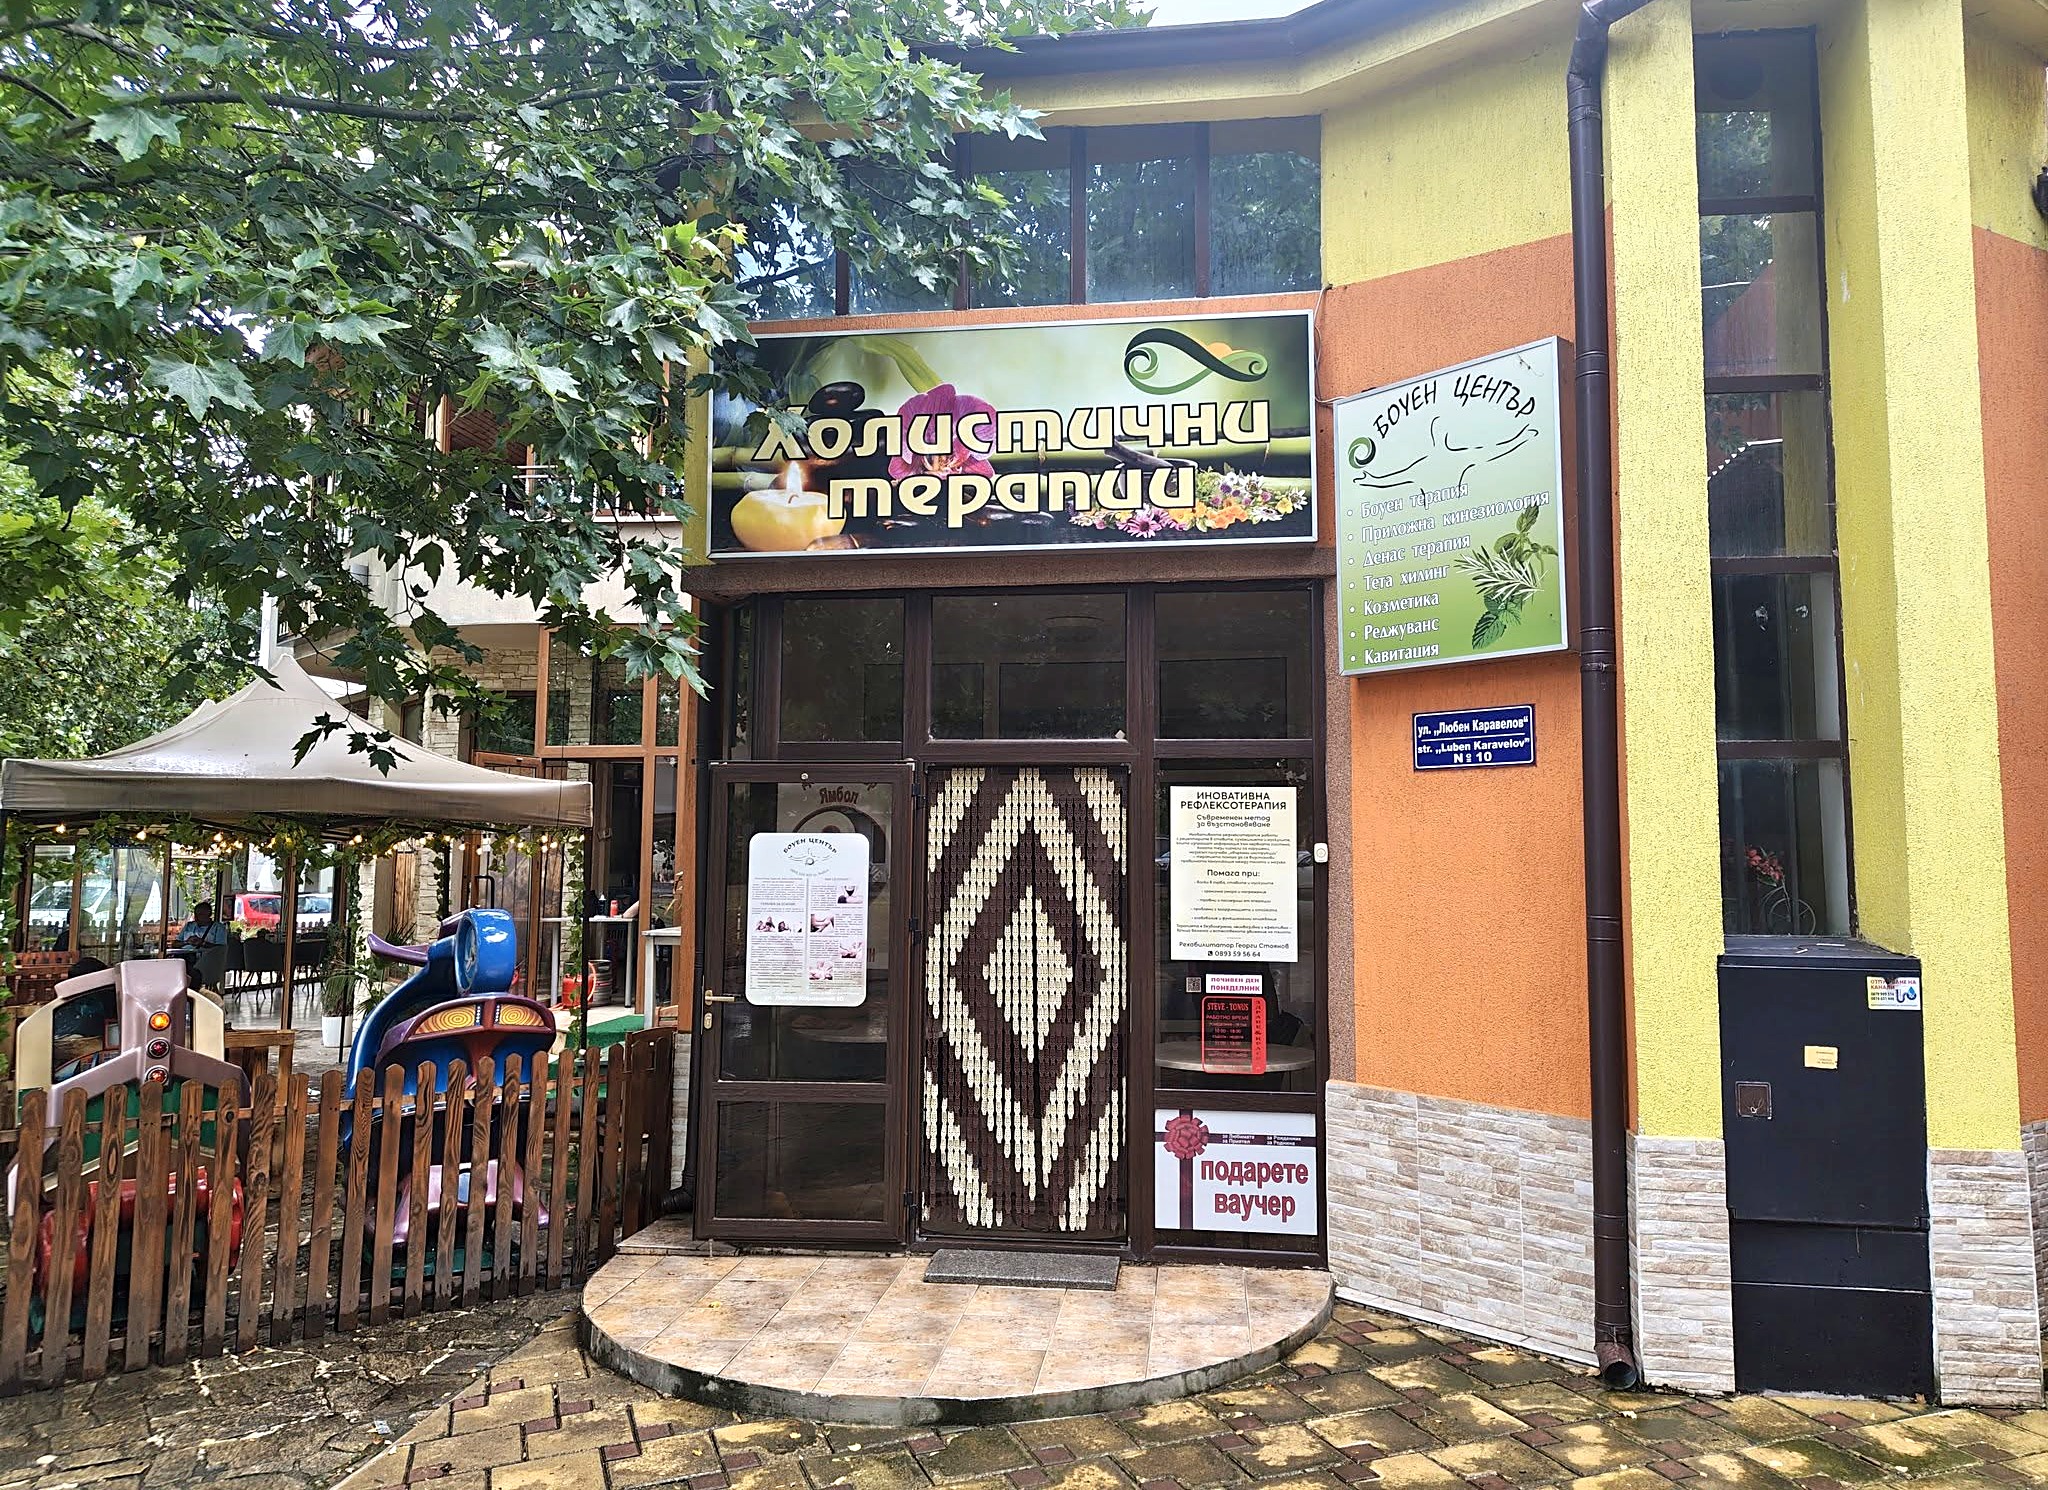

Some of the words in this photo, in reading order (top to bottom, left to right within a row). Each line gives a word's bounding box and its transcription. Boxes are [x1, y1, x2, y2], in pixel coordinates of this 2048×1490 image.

[1373, 380, 1437, 439] БОУЕН
[1453, 374, 1536, 418] ЦЕНТЪР
[827, 465, 1197, 528] терапии
[1361, 497, 1404, 520] Боуен
[1409, 484, 1469, 511] терапия
[1361, 516, 1436, 546] Приложна
[1442, 491, 1550, 527] кинезиология
[1363, 547, 1405, 568] Денас
[1412, 534, 1471, 560] терапия
[1364, 574, 1393, 591] Тета
[1400, 565, 1450, 585] хилинг
[1364, 593, 1439, 616] Козметика
[1364, 618, 1439, 641] Реджуванс
[1364, 643, 1440, 665] Кавитация
[1417, 725, 1432, 738] ул.
[1417, 745, 1433, 754] str.
[1475, 751, 1493, 762] 10
[819, 786, 860, 805] Ямбол
[1180, 800, 1287, 810] РЕФЛЕКСОТЕРАПИЯ
[1196, 791, 1271, 800] ИНОВАТИВНА
[1196, 814, 1243, 822] Съвременен
[1244, 815, 1271, 823] метод
[783, 838, 806, 854] БОУЕН
[1206, 869, 1240, 877] Помага
[1241, 869, 1261, 878] при:
[1201, 1160, 1309, 1189] подарете
[1214, 1193, 1296, 1223] ваучер
